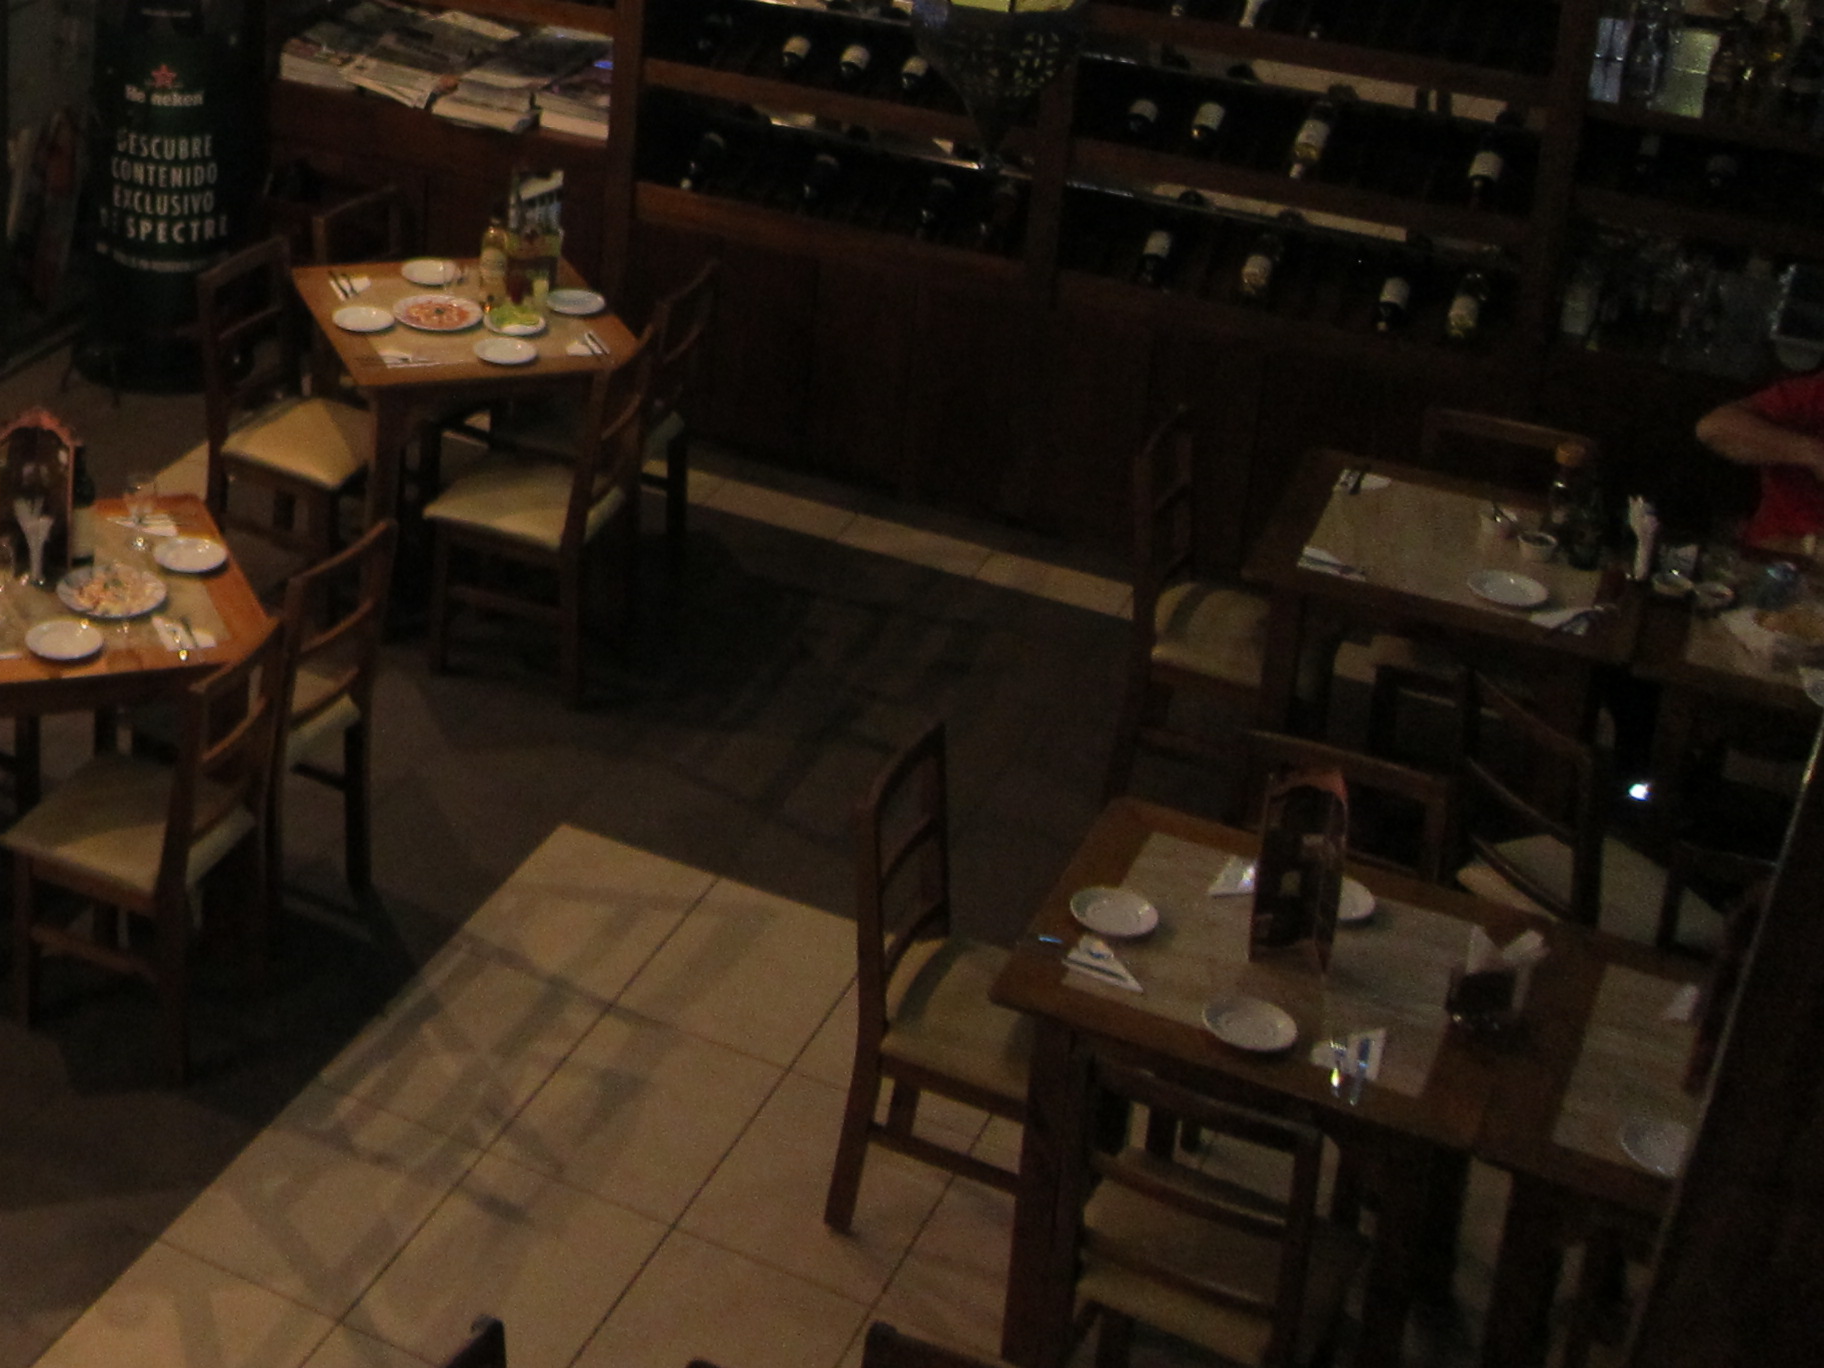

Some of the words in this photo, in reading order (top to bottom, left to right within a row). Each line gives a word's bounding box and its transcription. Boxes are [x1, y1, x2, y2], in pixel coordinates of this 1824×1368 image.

[116, 129, 213, 160] DESCUBRE
[110, 156, 219, 188] CONTENIDO
[112, 183, 216, 216] EXCLUSIVO
